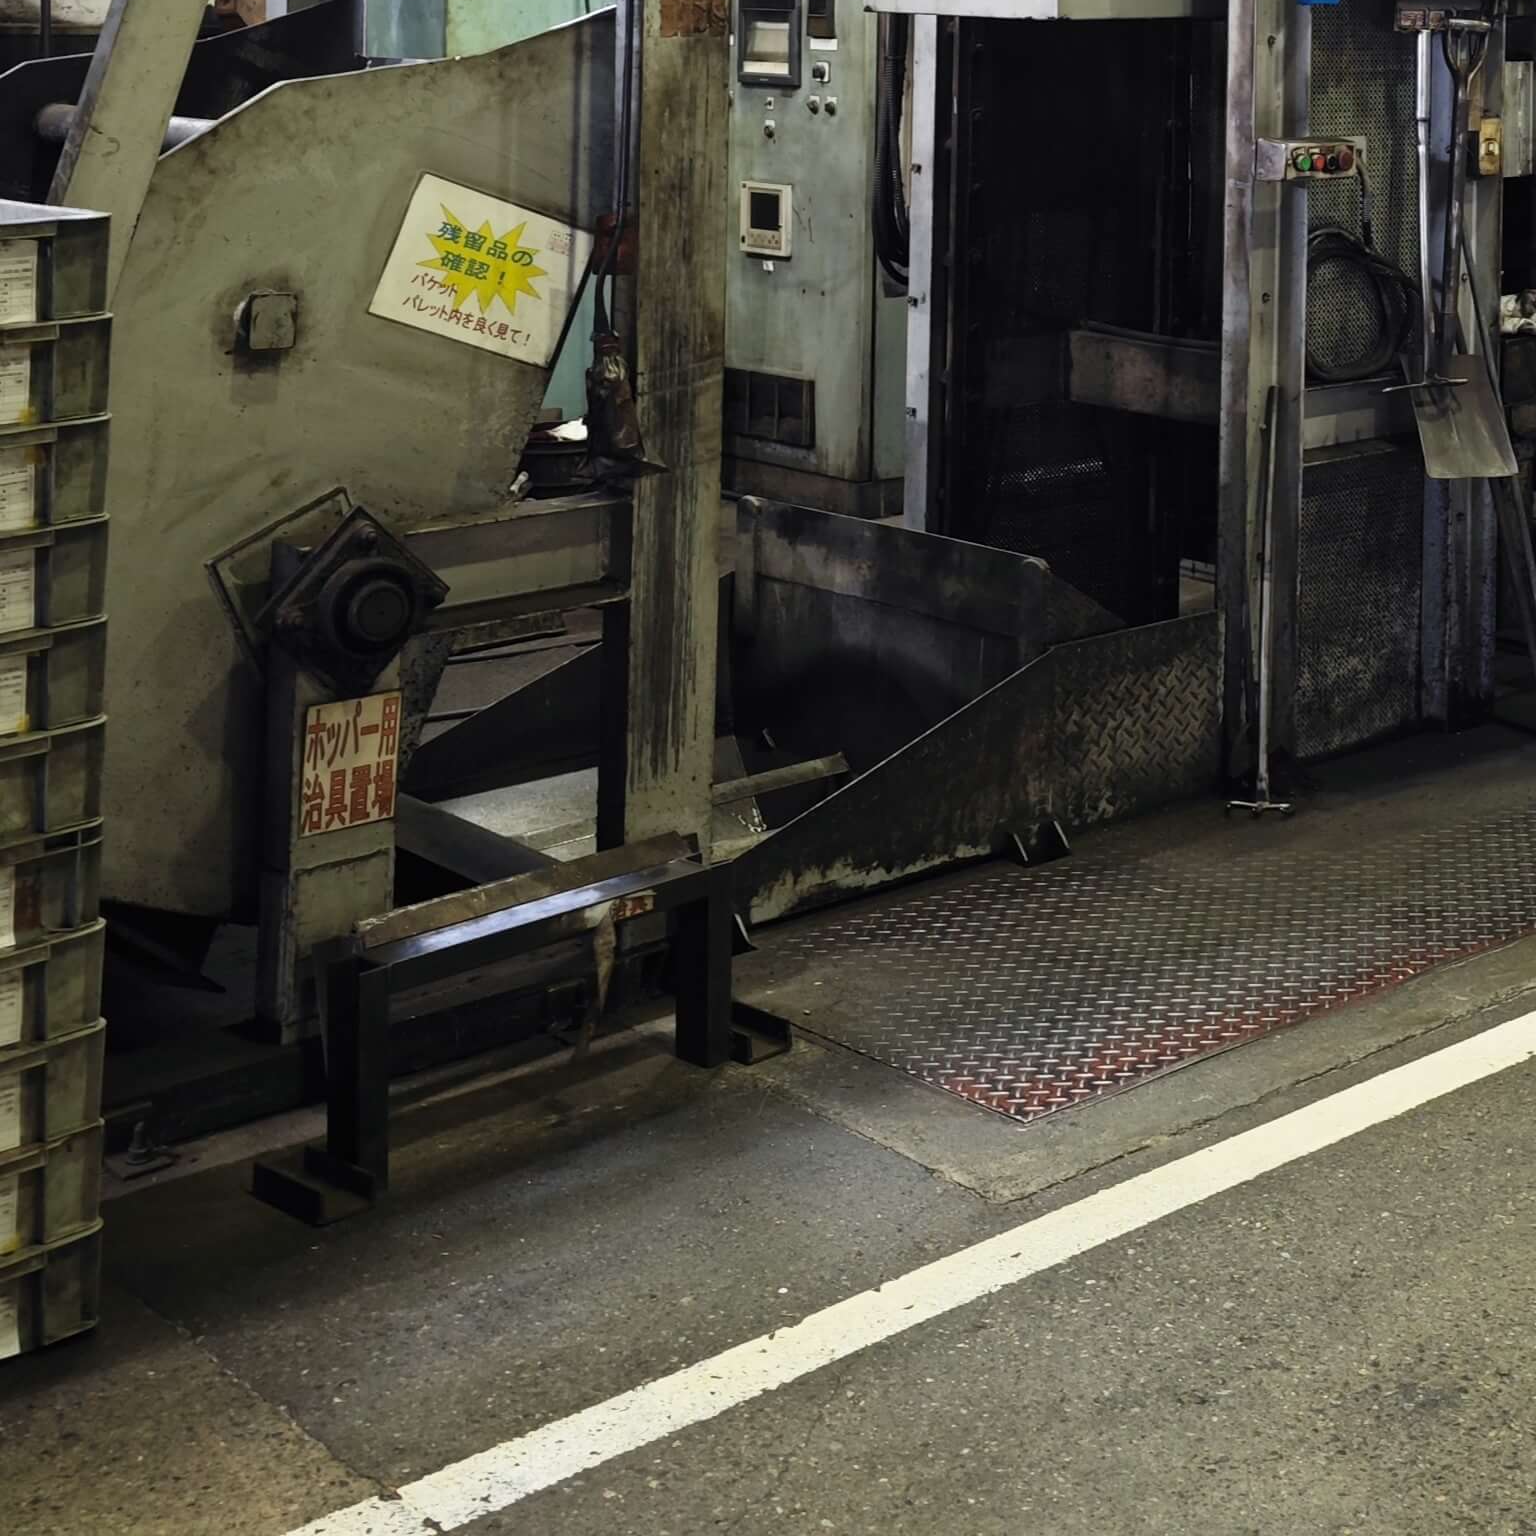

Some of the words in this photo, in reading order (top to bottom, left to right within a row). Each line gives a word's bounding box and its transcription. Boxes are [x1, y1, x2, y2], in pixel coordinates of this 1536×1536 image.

[437, 221, 535, 268] 残留品の
[307, 696, 401, 772] ホッパー用
[301, 759, 394, 834] 治具置場
